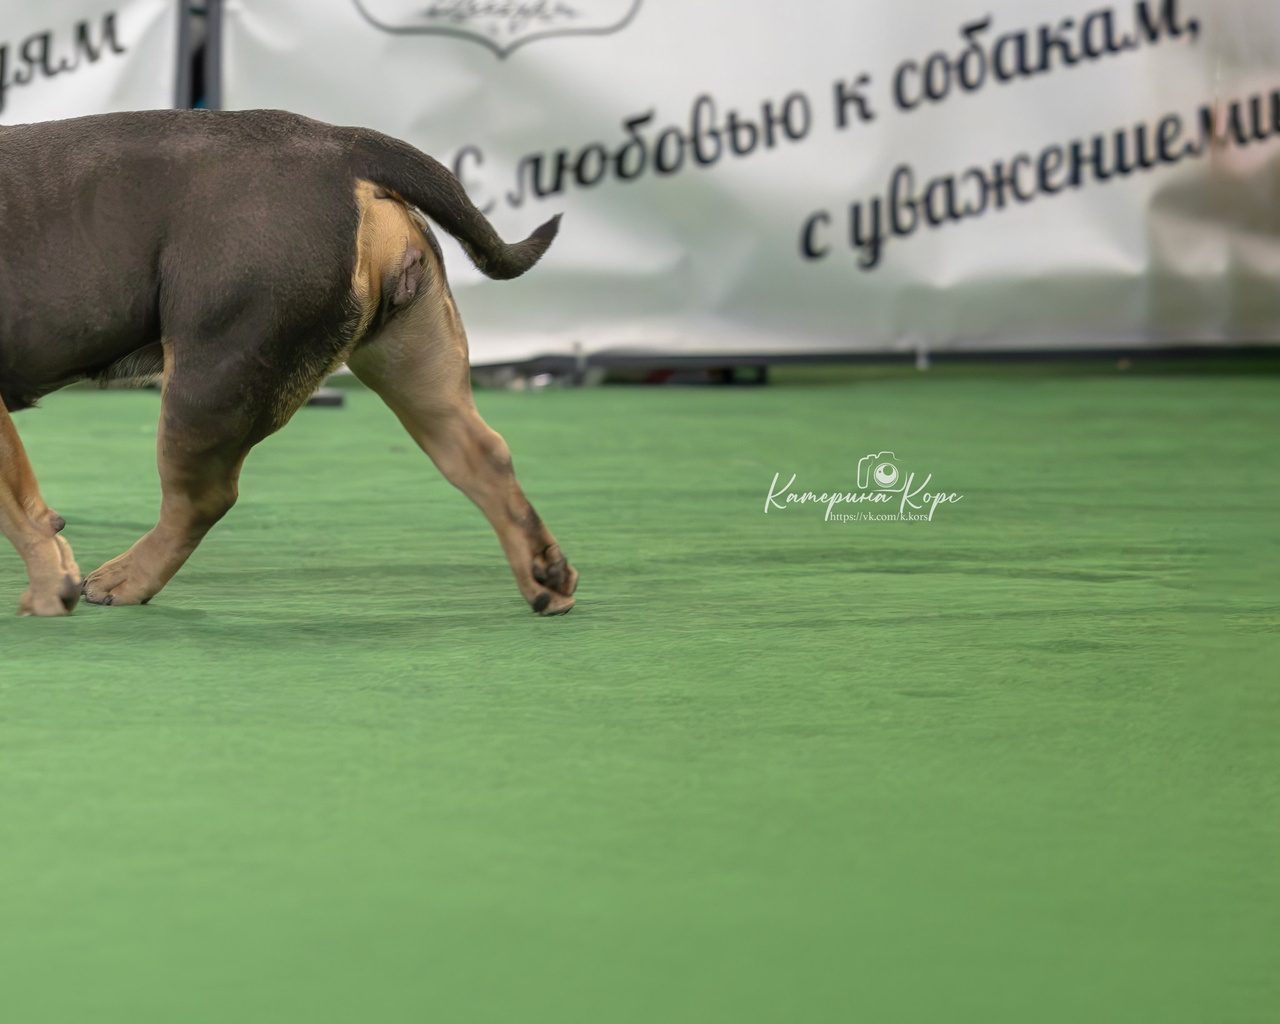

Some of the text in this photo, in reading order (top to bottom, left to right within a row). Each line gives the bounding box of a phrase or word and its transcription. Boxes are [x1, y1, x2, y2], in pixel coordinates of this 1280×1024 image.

[506, 93, 812, 208] любовью
[833, 72, 875, 130] к
[799, 209, 832, 262] с
